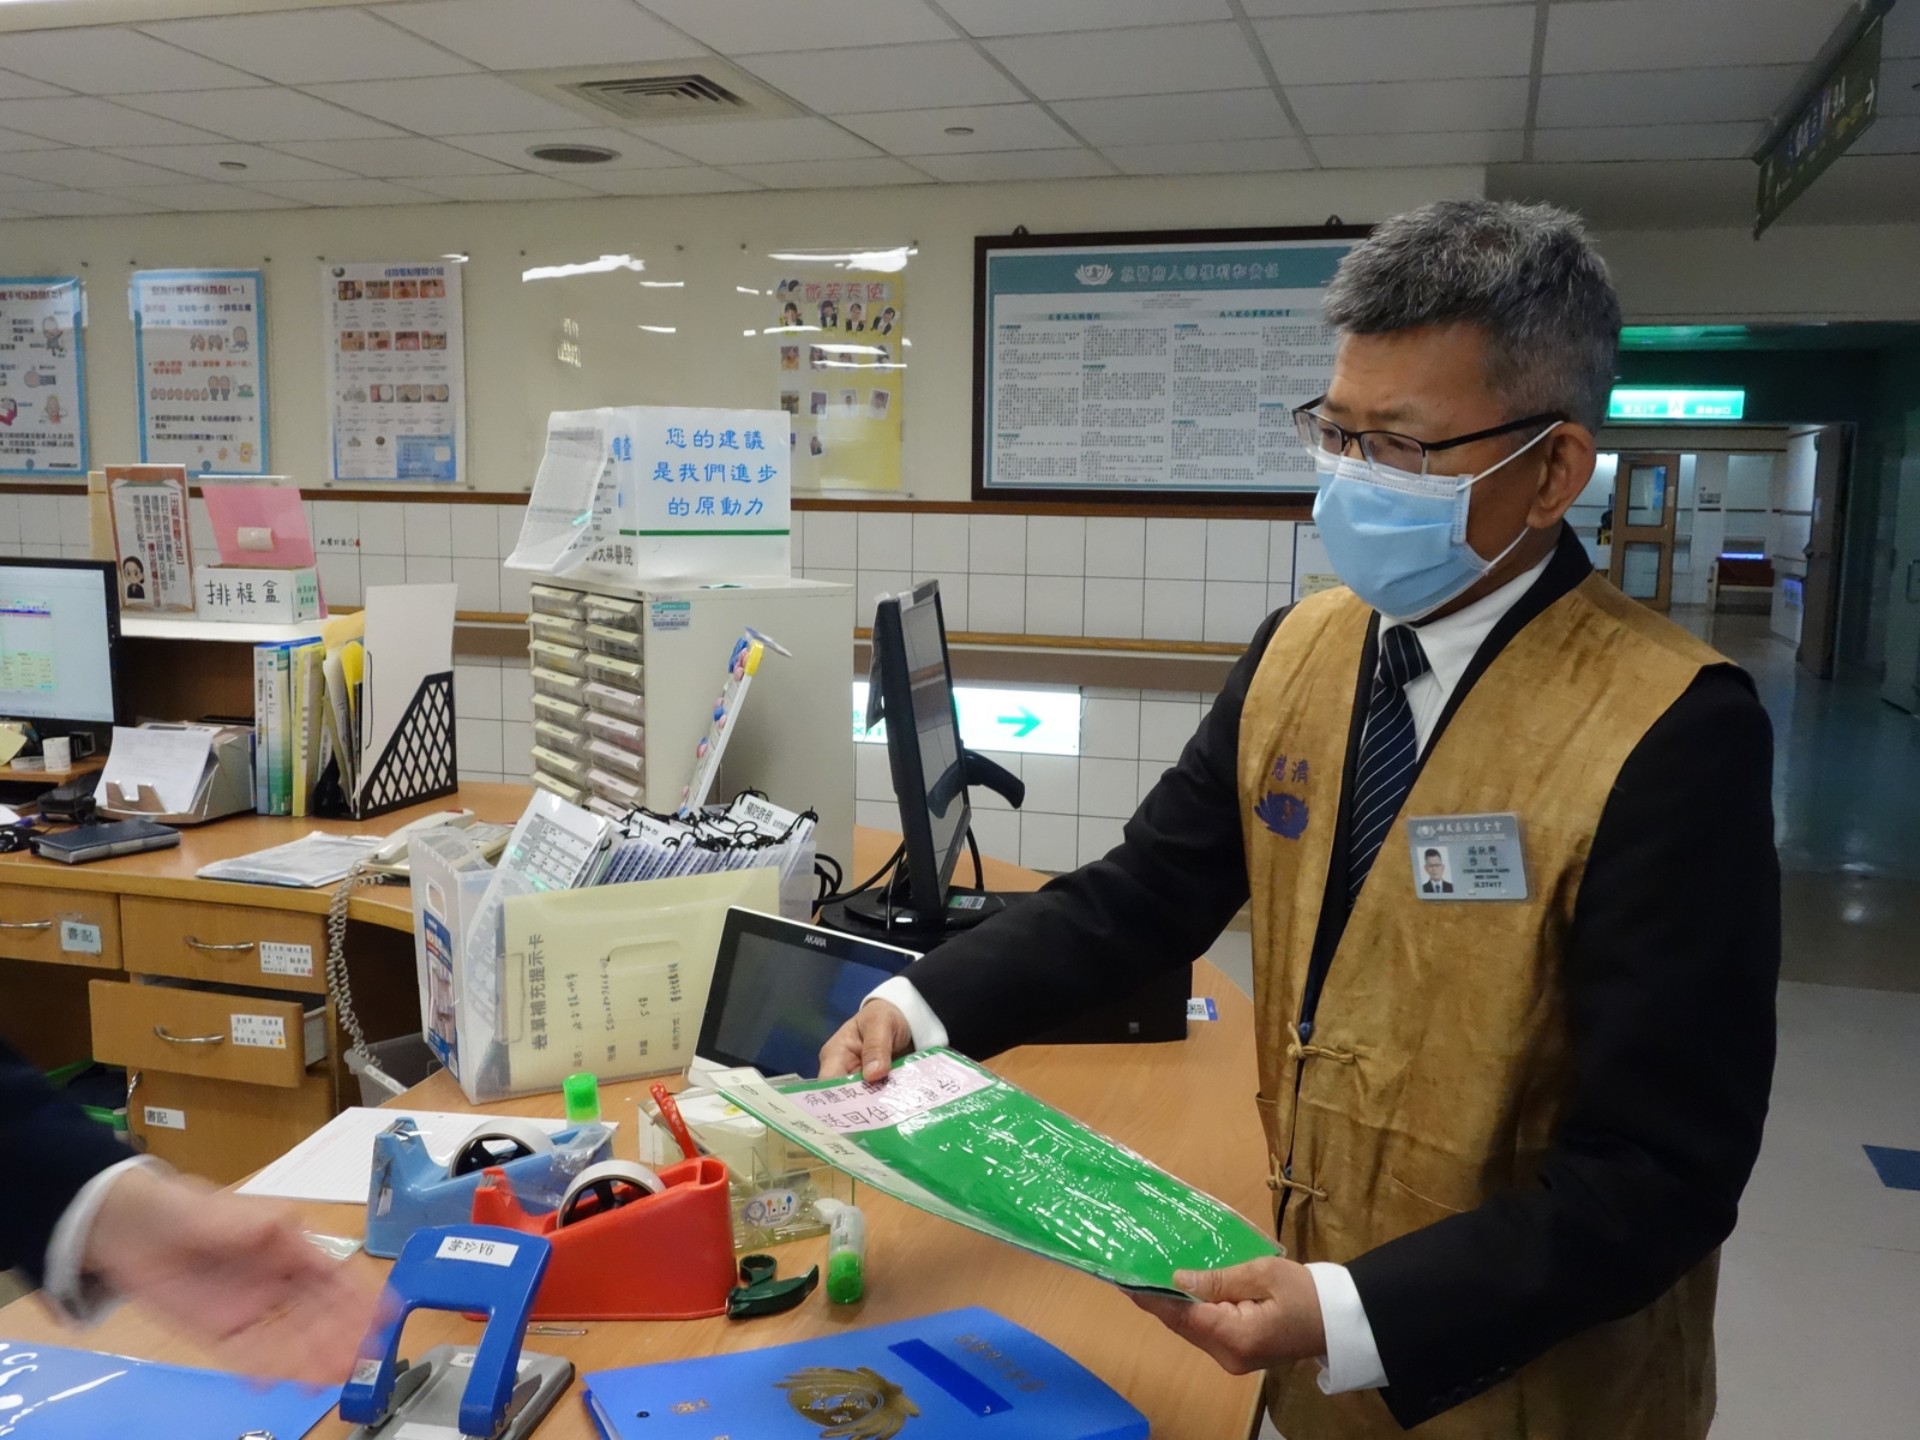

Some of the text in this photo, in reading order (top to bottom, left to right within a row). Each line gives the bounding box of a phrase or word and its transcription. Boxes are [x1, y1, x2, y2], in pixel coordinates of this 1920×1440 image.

[805, 282, 885, 301] 微笑天使
[665, 427, 765, 450] 您的建議
[653, 461, 778, 484] 是我們進步
[668, 496, 764, 516] 的原動力
[204, 580, 280, 606] 排程盒
[67, 927, 94, 944] 書記
[804, 933, 828, 949] AKAWA
[528, 934, 547, 1050] 表單補充提示卡
[146, 1109, 168, 1125] 書記
